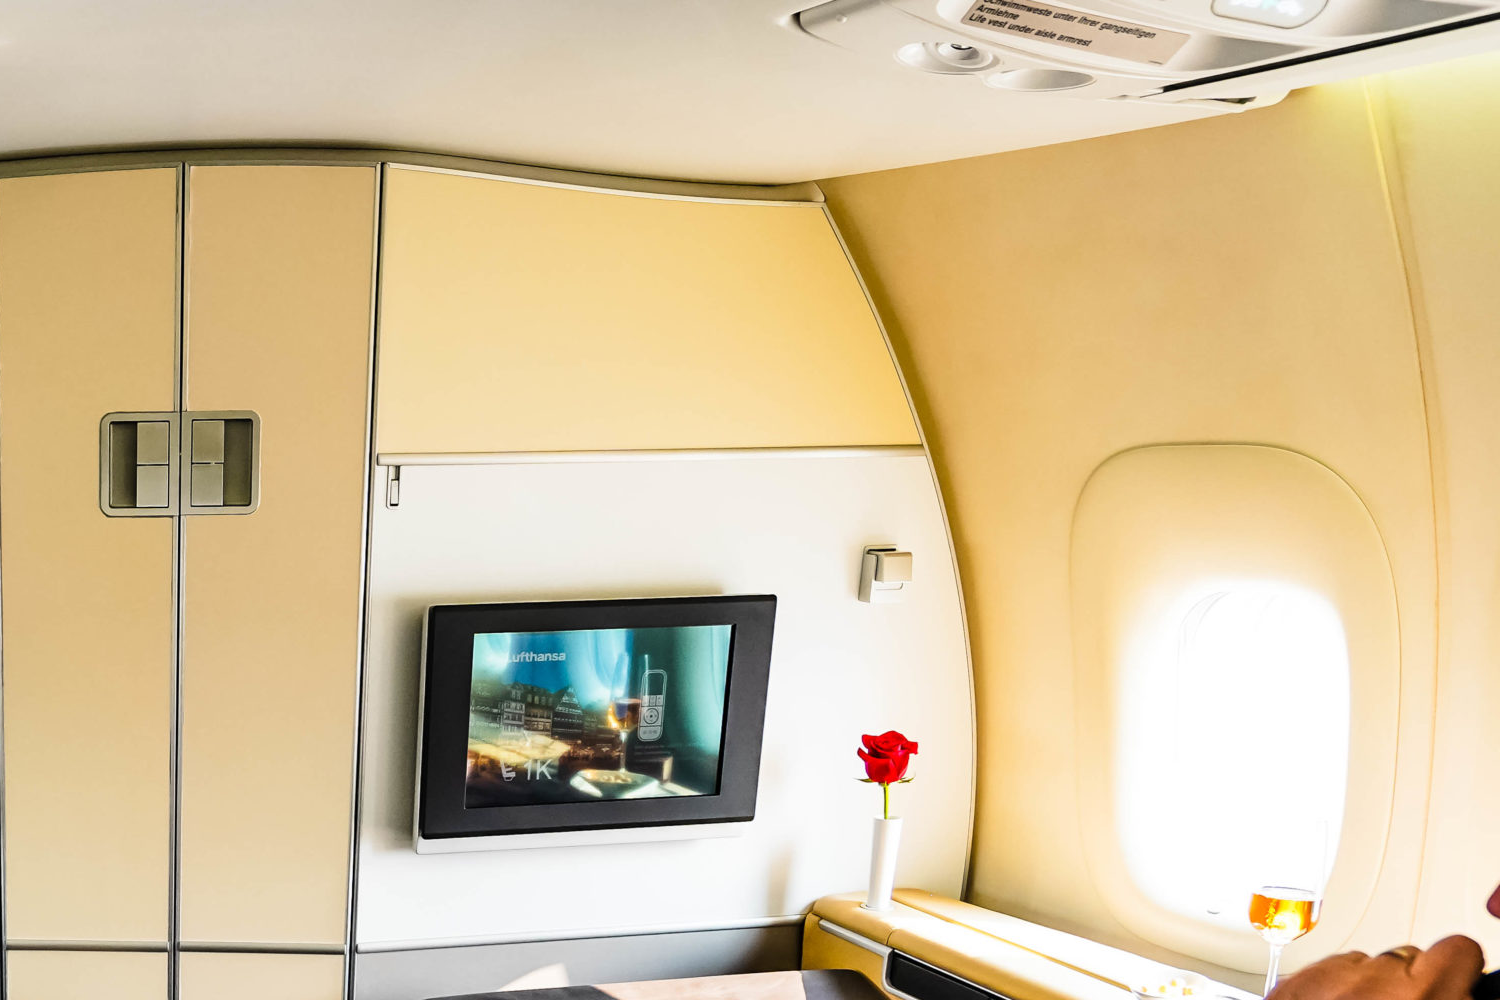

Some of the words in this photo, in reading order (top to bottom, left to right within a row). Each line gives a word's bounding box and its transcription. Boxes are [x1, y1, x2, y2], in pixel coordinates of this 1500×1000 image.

[976, 4, 1020, 20] Armlehne
[968, 13, 987, 24] Life
[988, 19, 1008, 28] vest
[1008, 23, 1035, 34] under
[1034, 29, 1057, 39] aisle
[1056, 34, 1092, 47] armrest
[1053, 12, 1078, 23] unter
[1078, 16, 1100, 27] Ihrer
[1099, 22, 1157, 39] gangseitigen
[523, 759, 553, 781] 1K
